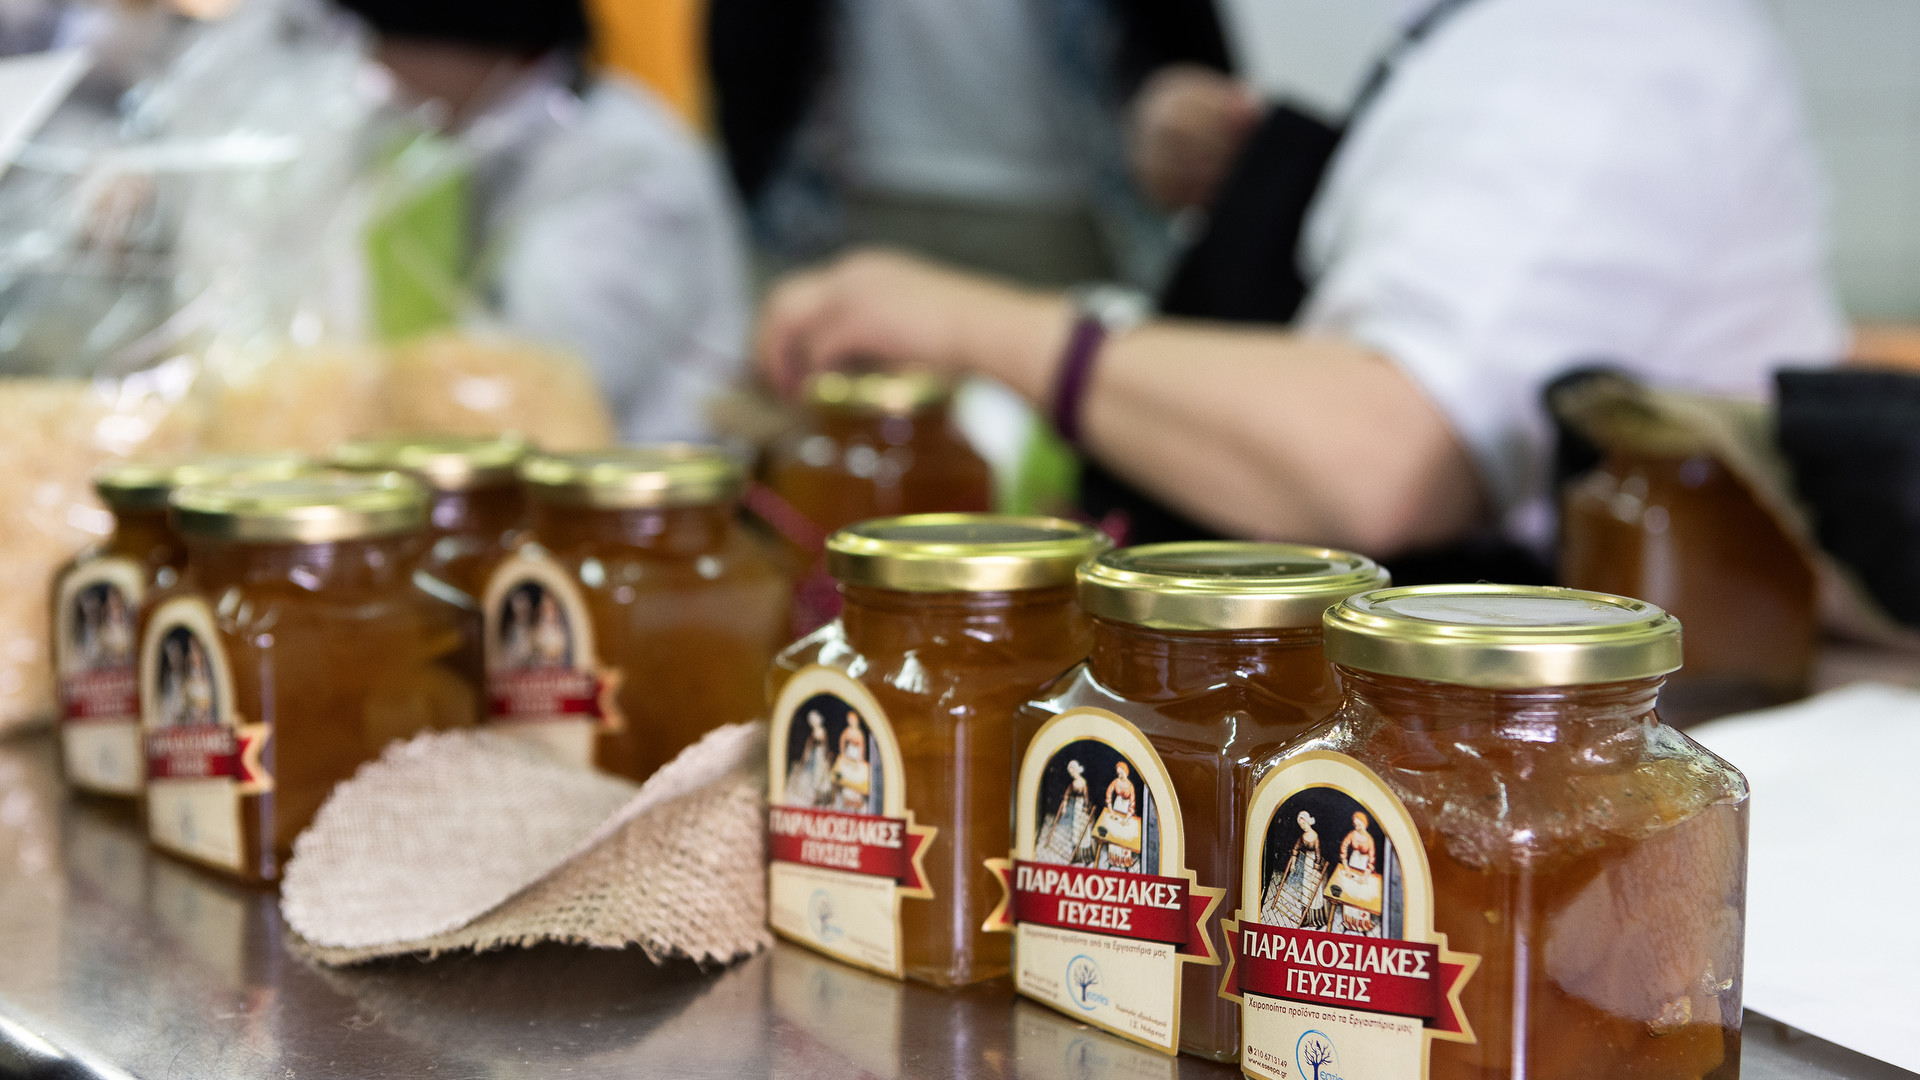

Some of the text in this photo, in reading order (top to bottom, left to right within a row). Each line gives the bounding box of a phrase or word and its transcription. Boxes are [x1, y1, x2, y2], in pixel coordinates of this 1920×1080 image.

[1016, 866, 1182, 910] ΠΑΡΑΔΟΣΙΑΚΕΣ
[1057, 900, 1132, 931] ΓΕΥΣΕΙΣ
[1153, 949, 1167, 959] μας
[1243, 929, 1431, 980] ΠΑΡΑΔΟΣΙΑΚΕΣ
[1286, 968, 1371, 1003] ΓΕΥΣΕΙΣ
[1248, 996, 1287, 1014] Χειροποίητα
[1288, 1007, 1320, 1020] προϊόντα
[1321, 1011, 1337, 1022] από
[1338, 1015, 1347, 1024] τα
[1253, 1047, 1288, 1068] 210 6713149
